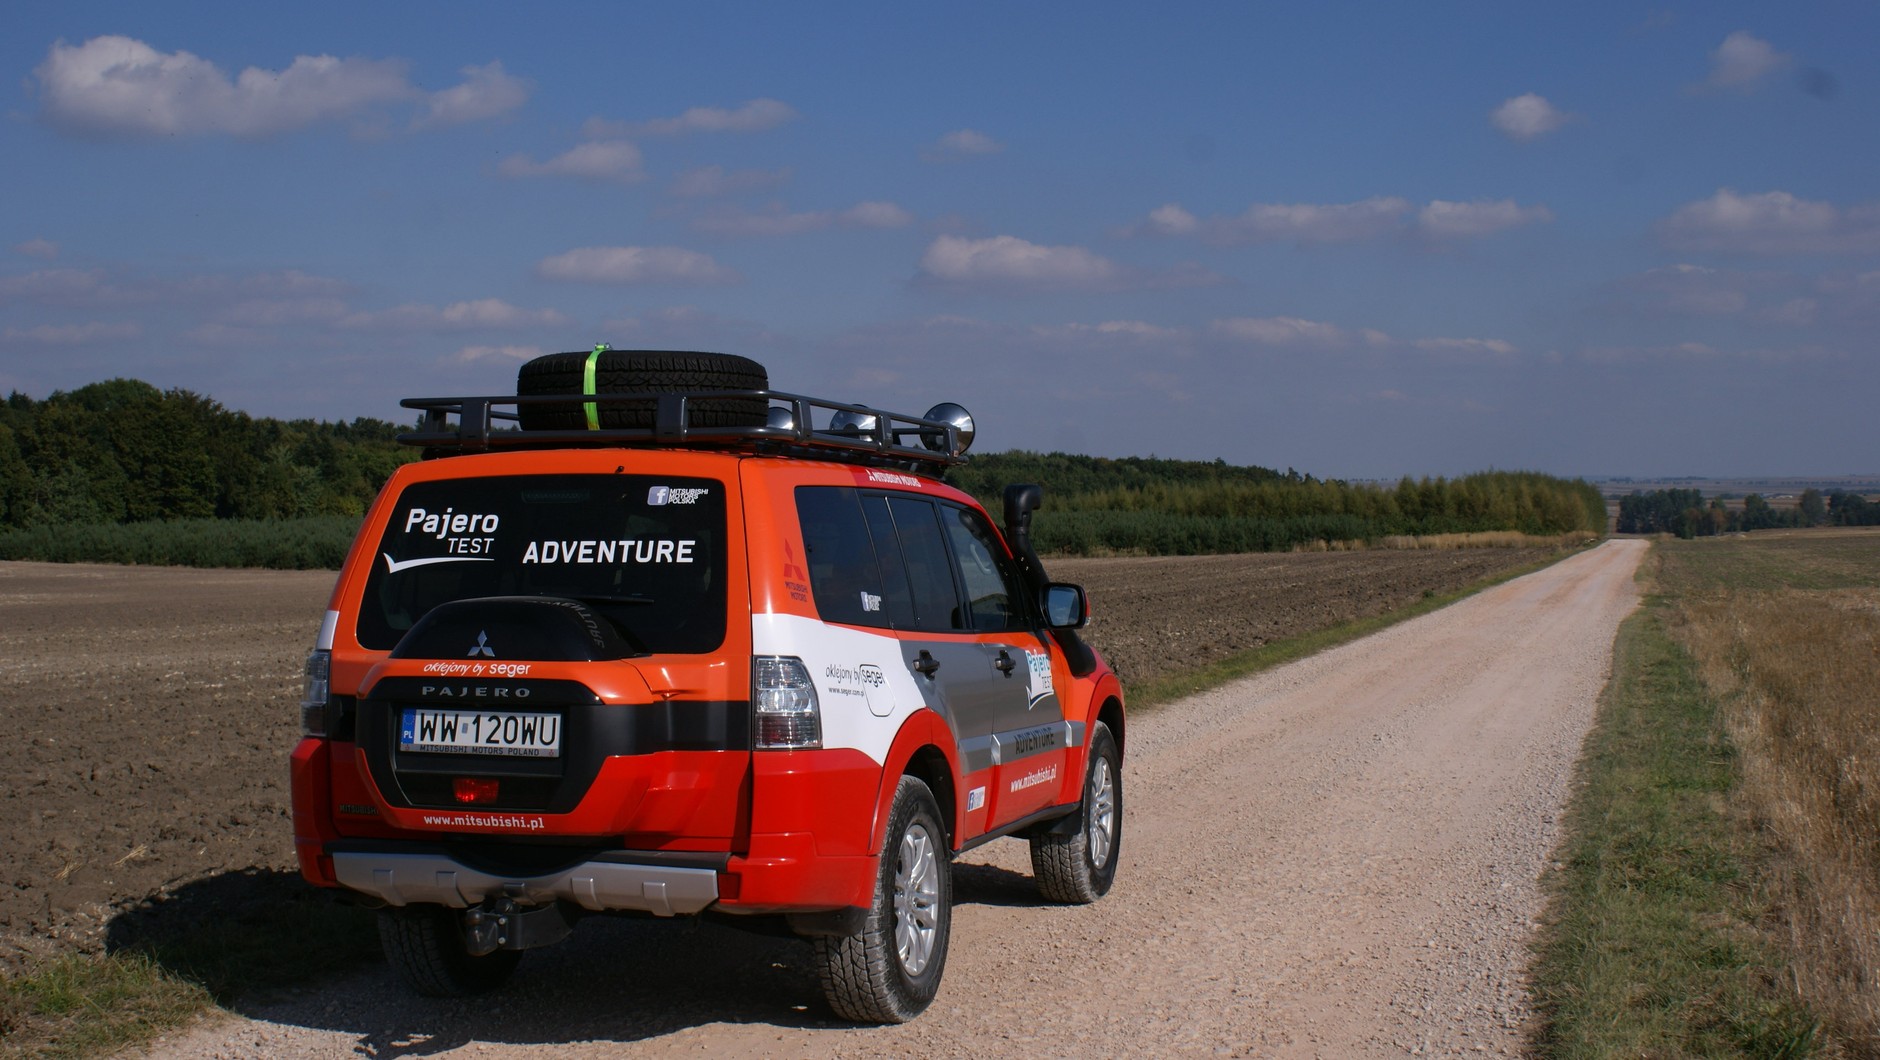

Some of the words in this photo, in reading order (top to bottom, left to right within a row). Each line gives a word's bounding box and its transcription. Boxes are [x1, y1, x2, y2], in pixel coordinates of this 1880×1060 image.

[404, 507, 500, 539] Pajero
[447, 538, 495, 554] TEST
[522, 540, 696, 564] ADVENTURE
[423, 662, 472, 676] oklejony
[472, 664, 486, 676] by
[489, 663, 532, 678] seger
[825, 664, 852, 685] oklejony
[853, 667, 860, 685] by
[421, 686, 531, 699] PAJERO
[403, 730, 414, 739] PL
[419, 712, 460, 743] WW
[472, 714, 557, 746] 120WU
[419, 744, 468, 754] MITSUBISHI
[471, 746, 504, 756] MOTORS
[507, 748, 540, 757] POLAND
[1013, 727, 1055, 755] ADVENTURE
[1010, 763, 1057, 793] www.mitsubishi.pl
[423, 814, 545, 831] www.mitsubishi.pl
